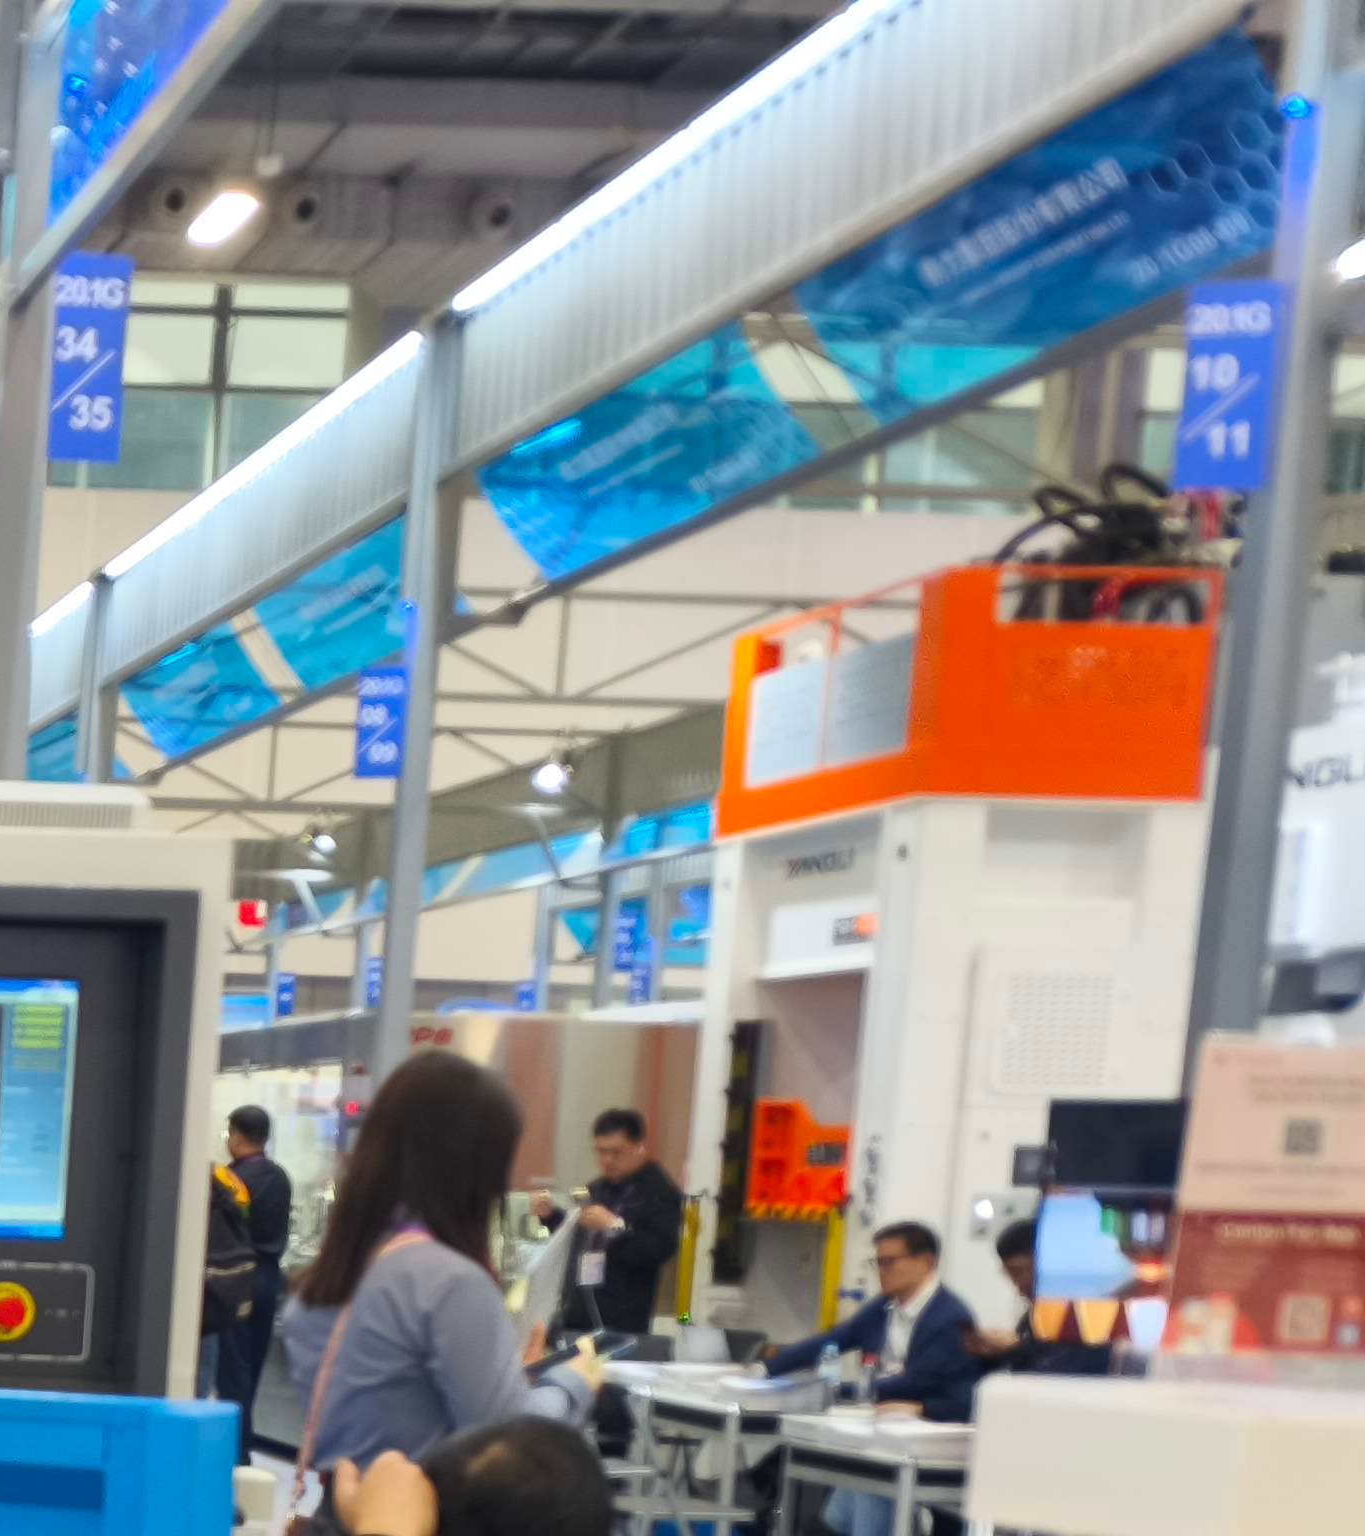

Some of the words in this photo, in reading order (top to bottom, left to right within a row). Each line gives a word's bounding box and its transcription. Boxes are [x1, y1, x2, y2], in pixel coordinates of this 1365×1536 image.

[56, 274, 125, 309] 20.1G
[54, 325, 98, 362] 34
[1191, 353, 1239, 393] 10
[68, 394, 113, 432] 35
[1208, 420, 1251, 460] 11
